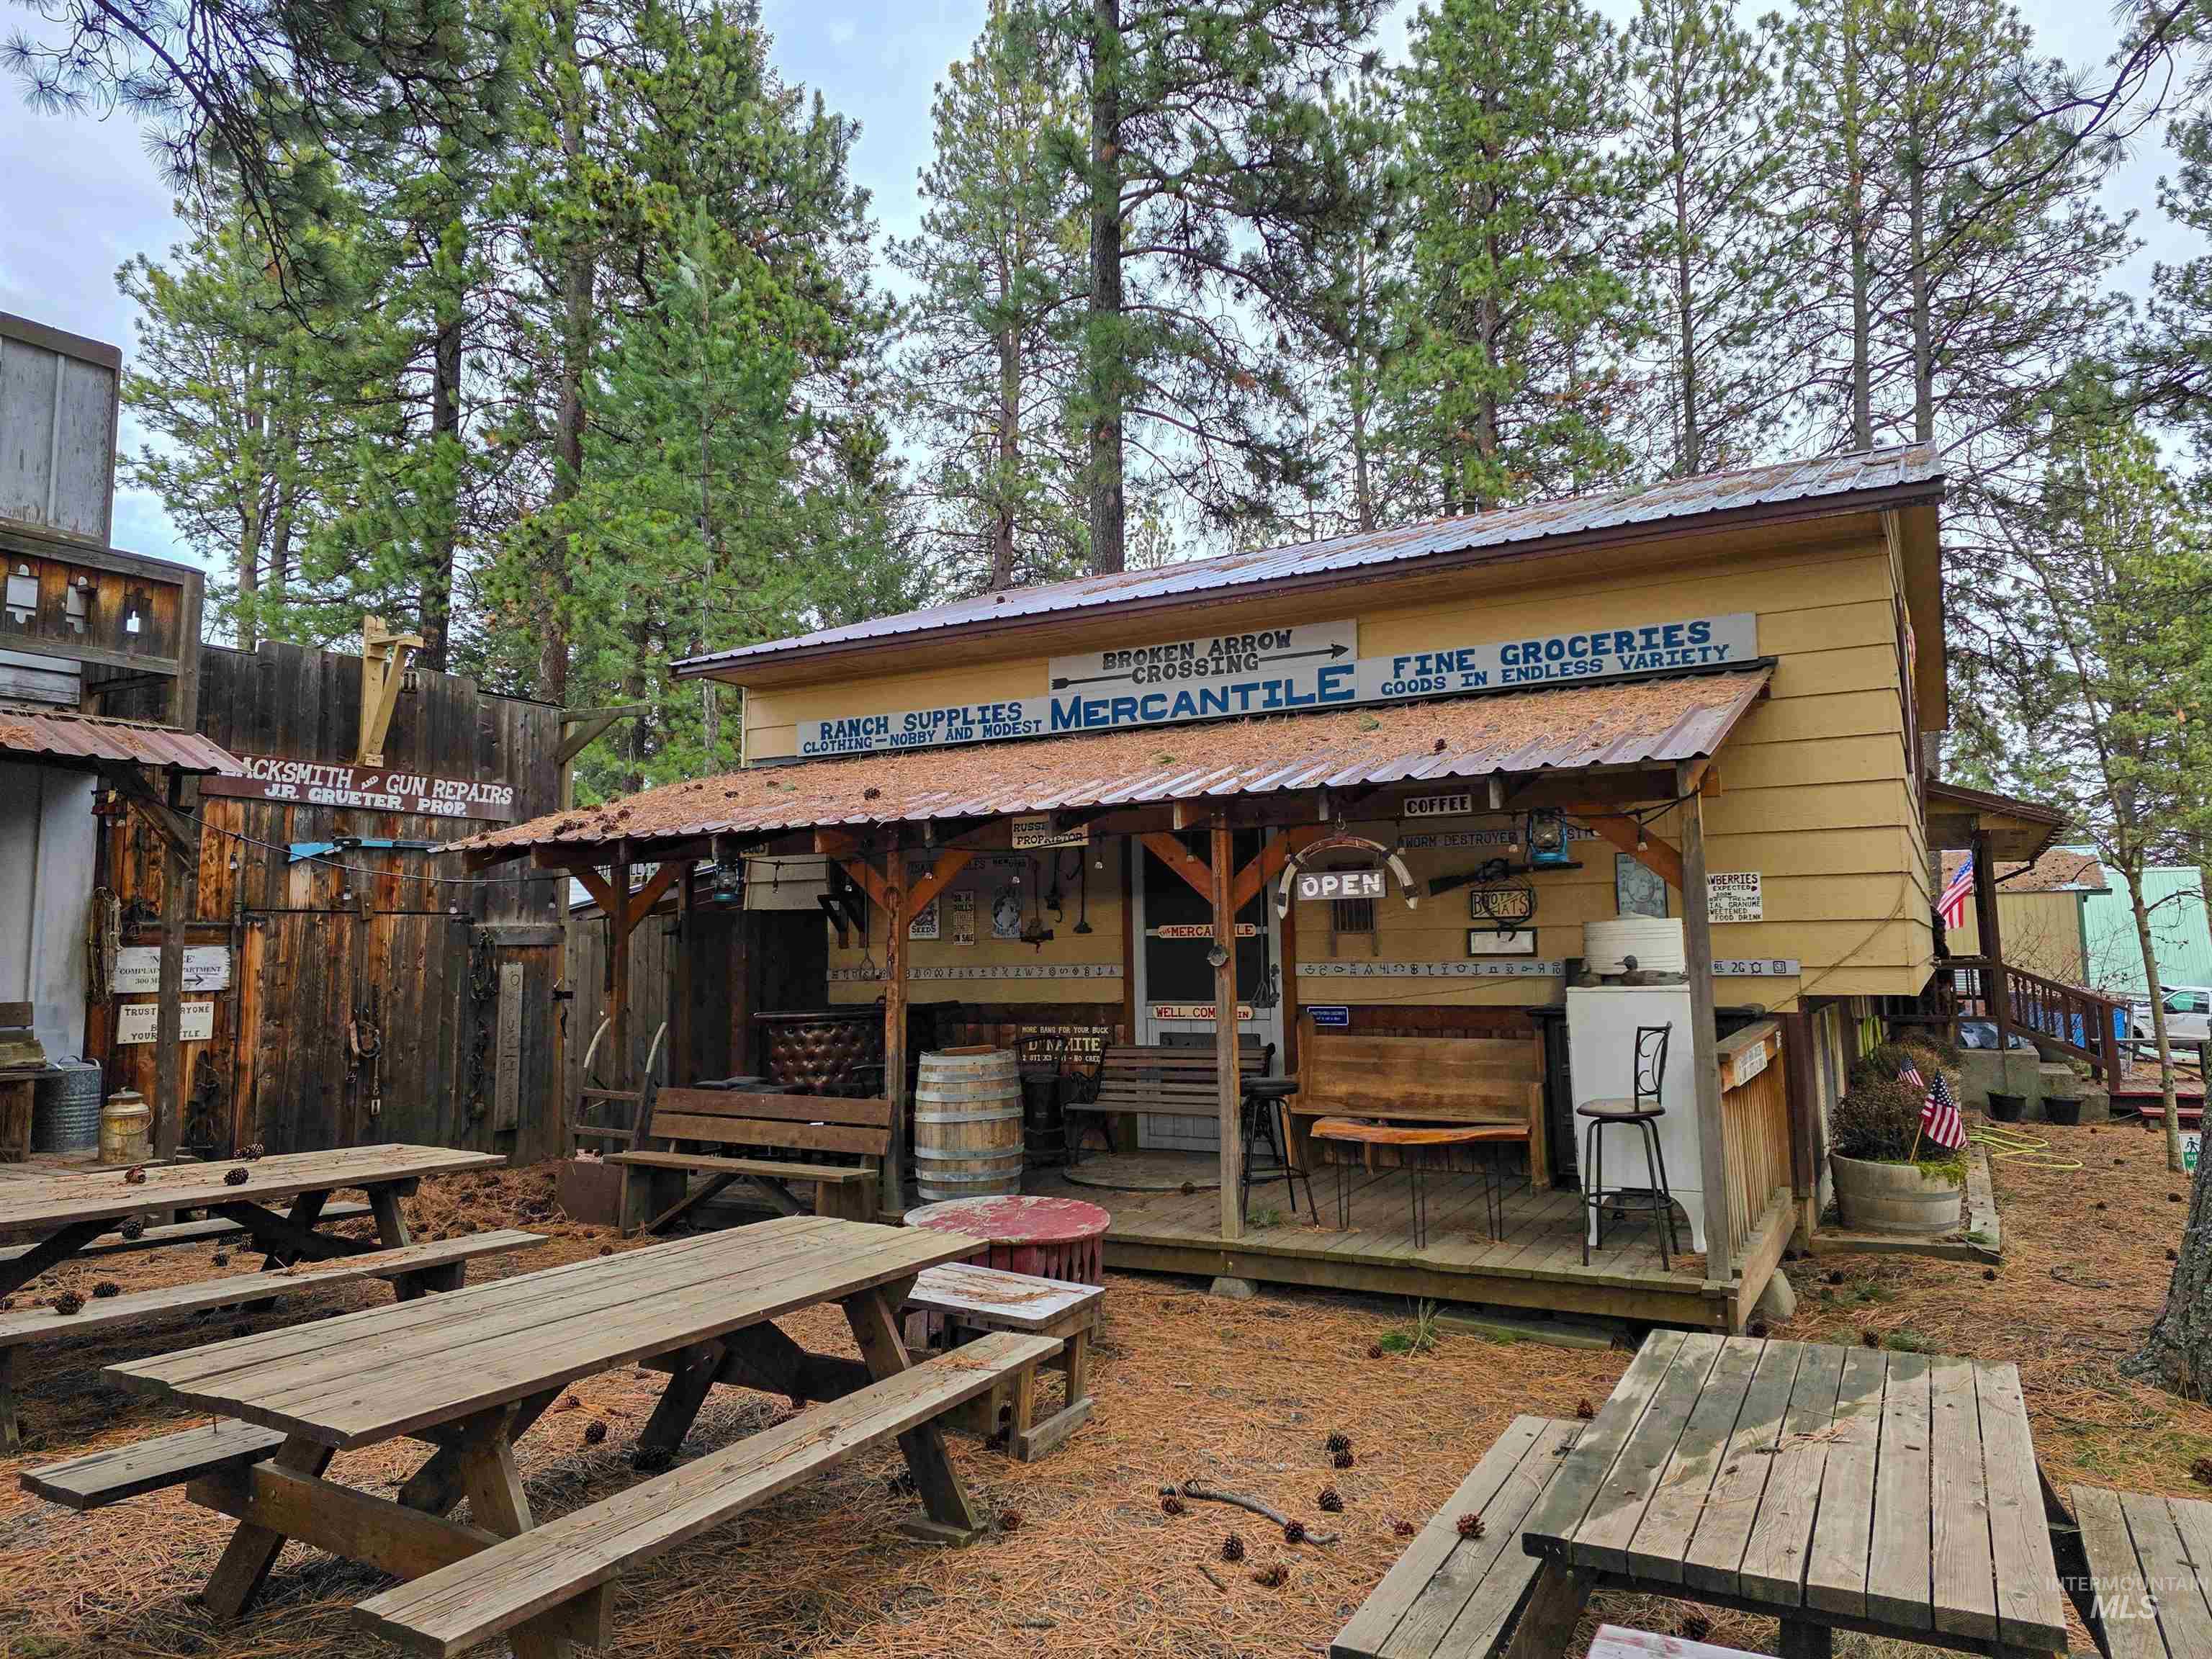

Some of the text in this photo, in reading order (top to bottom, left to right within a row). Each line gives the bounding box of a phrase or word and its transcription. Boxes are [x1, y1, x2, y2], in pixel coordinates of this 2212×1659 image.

[1102, 629, 1292, 670] BROKEN ARROW
[1393, 621, 1712, 679] FINE GROCERIES
[1131, 652, 1259, 684] CROSSING
[1381, 644, 1730, 696] GOODS IN ENDLESS VARIETY
[1051, 664, 1355, 731] MERCANTILE
[821, 702, 1022, 740] RANCH SUPPLIES
[945, 726, 972, 741] AND
[982, 719, 1043, 739] MODEST
[218, 757, 513, 805] ACKSMITH AND GUN REPAIRS
[264, 783, 300, 799] J.R.
[417, 798, 467, 815] PROP.
[1406, 798, 1467, 814] COFFEE
[1406, 836, 1437, 847] WORM
[1302, 873, 1380, 897] OPEN
[912, 925, 936, 933] SEEDS
[1172, 925, 1253, 936] MERCALE
[125, 1007, 156, 1016] TRUST
[1156, 1007, 1185, 1017] WELL
[1193, 1007, 1215, 1017] COM
[1028, 1037, 1100, 1051] DNAMITE
